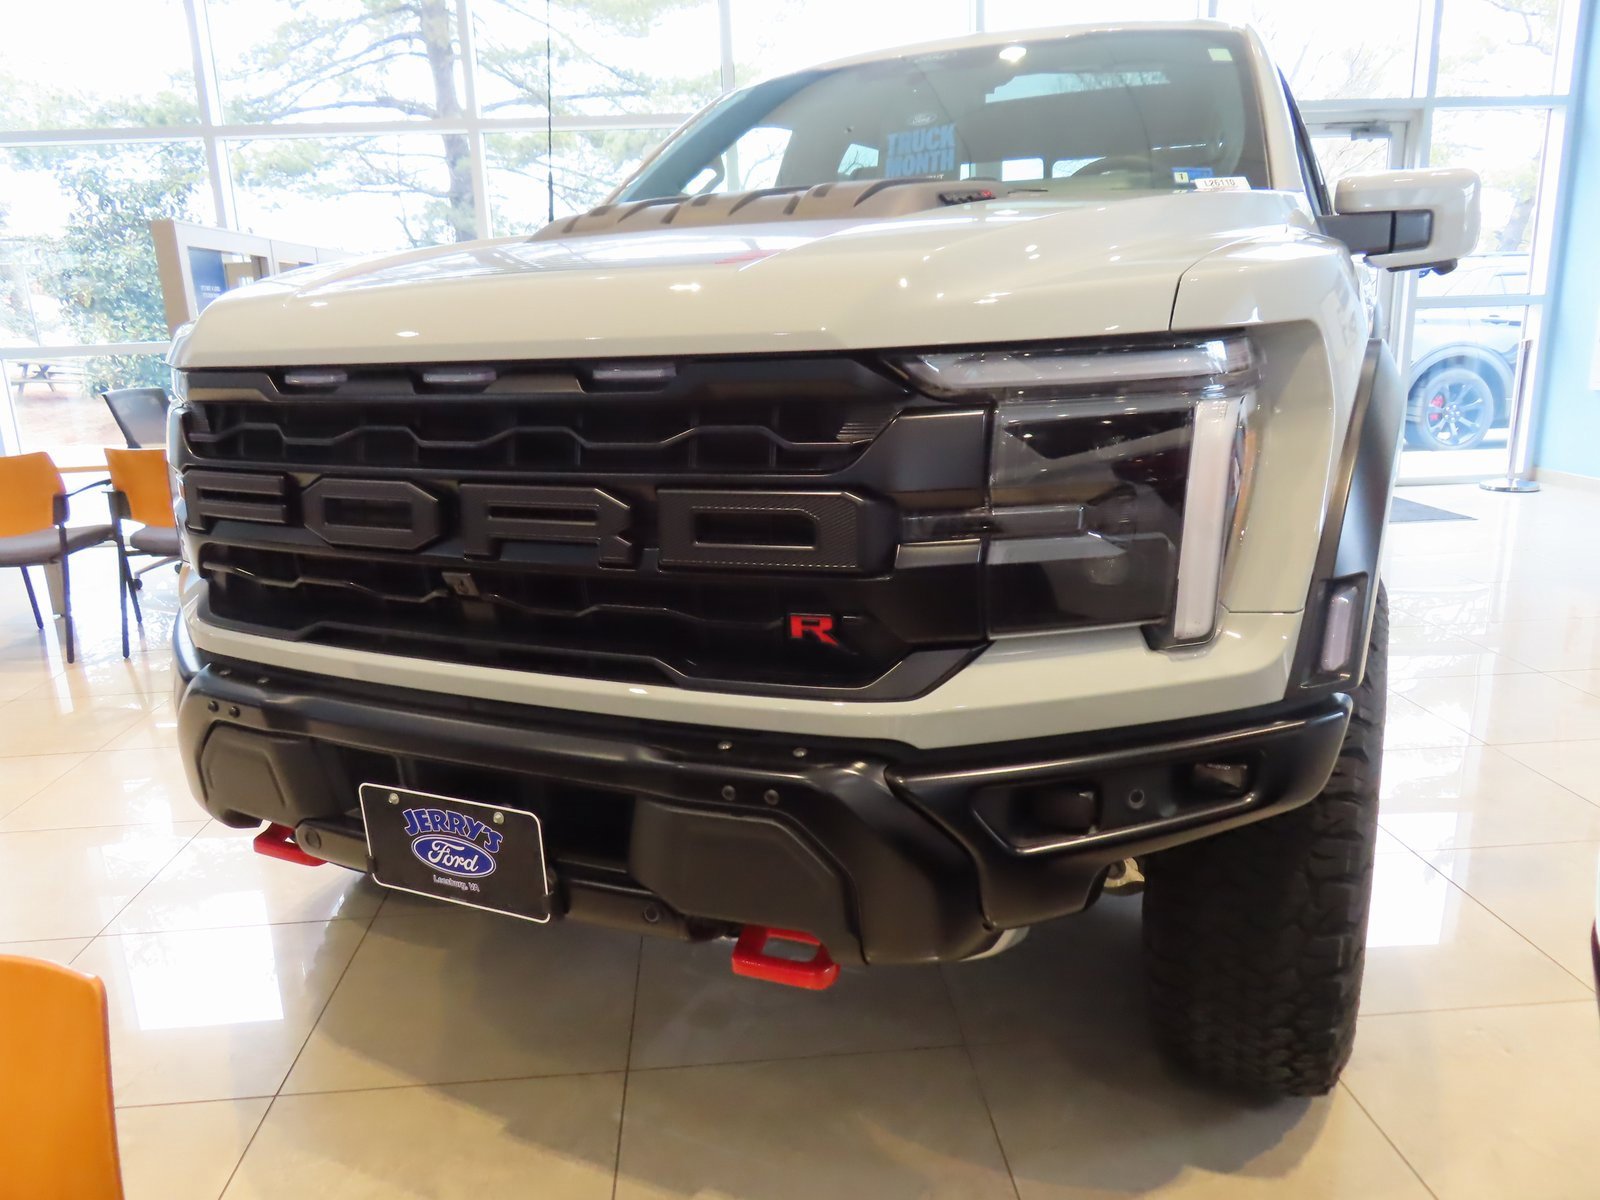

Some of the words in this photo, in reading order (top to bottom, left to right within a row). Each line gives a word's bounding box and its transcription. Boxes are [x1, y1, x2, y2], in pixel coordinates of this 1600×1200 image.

[887, 122, 956, 155] TRUCK
[885, 147, 956, 178] MONTH
[182, 469, 868, 573] FORD
[790, 612, 839, 647] R
[402, 808, 503, 854] JERRY'S
[427, 840, 479, 873] Ford
